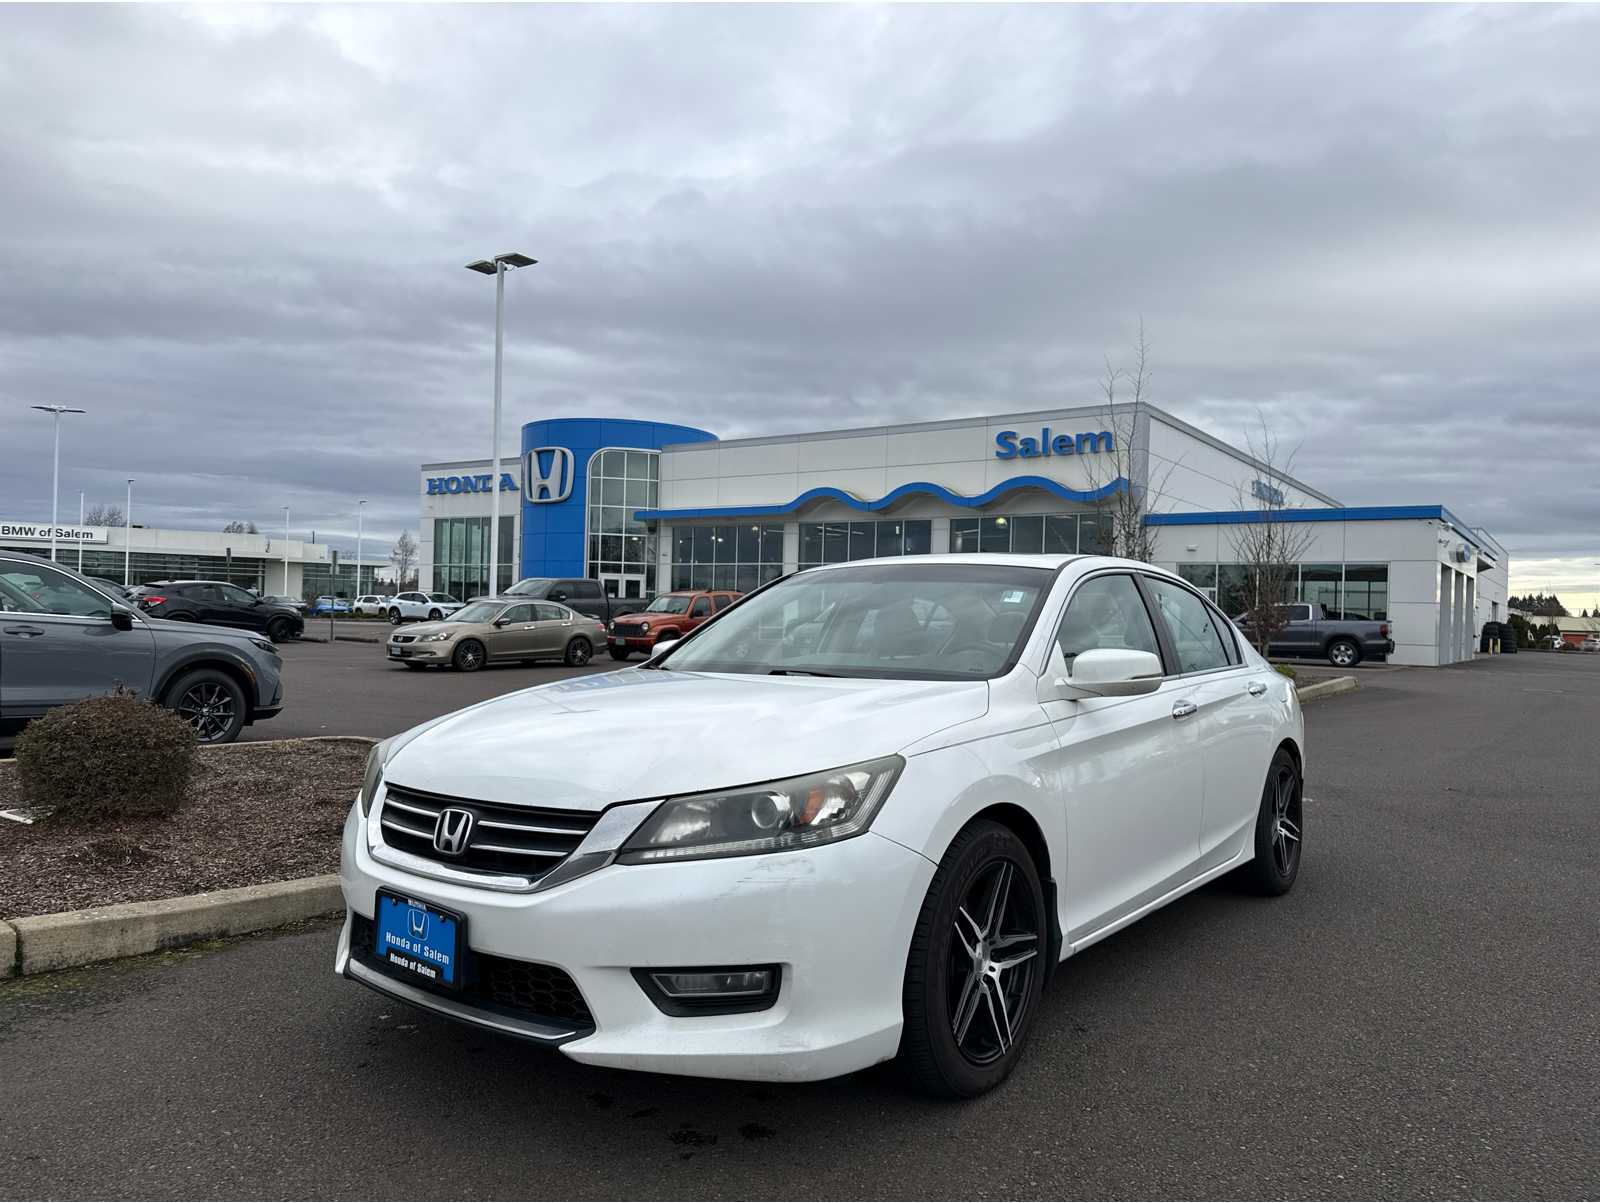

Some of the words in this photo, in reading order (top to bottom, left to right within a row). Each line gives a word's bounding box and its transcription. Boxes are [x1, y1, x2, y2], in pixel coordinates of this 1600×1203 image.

[995, 427, 1113, 460] Salem
[1, 525, 36, 536] BMW
[39, 527, 52, 537] of
[55, 528, 93, 539] Salem
[386, 931, 410, 950] Honda
[413, 943, 421, 953] of
[424, 946, 449, 965] Salem
[390, 952, 409, 968] Honda
[409, 961, 416, 971] of
[417, 963, 436, 978] Salem
